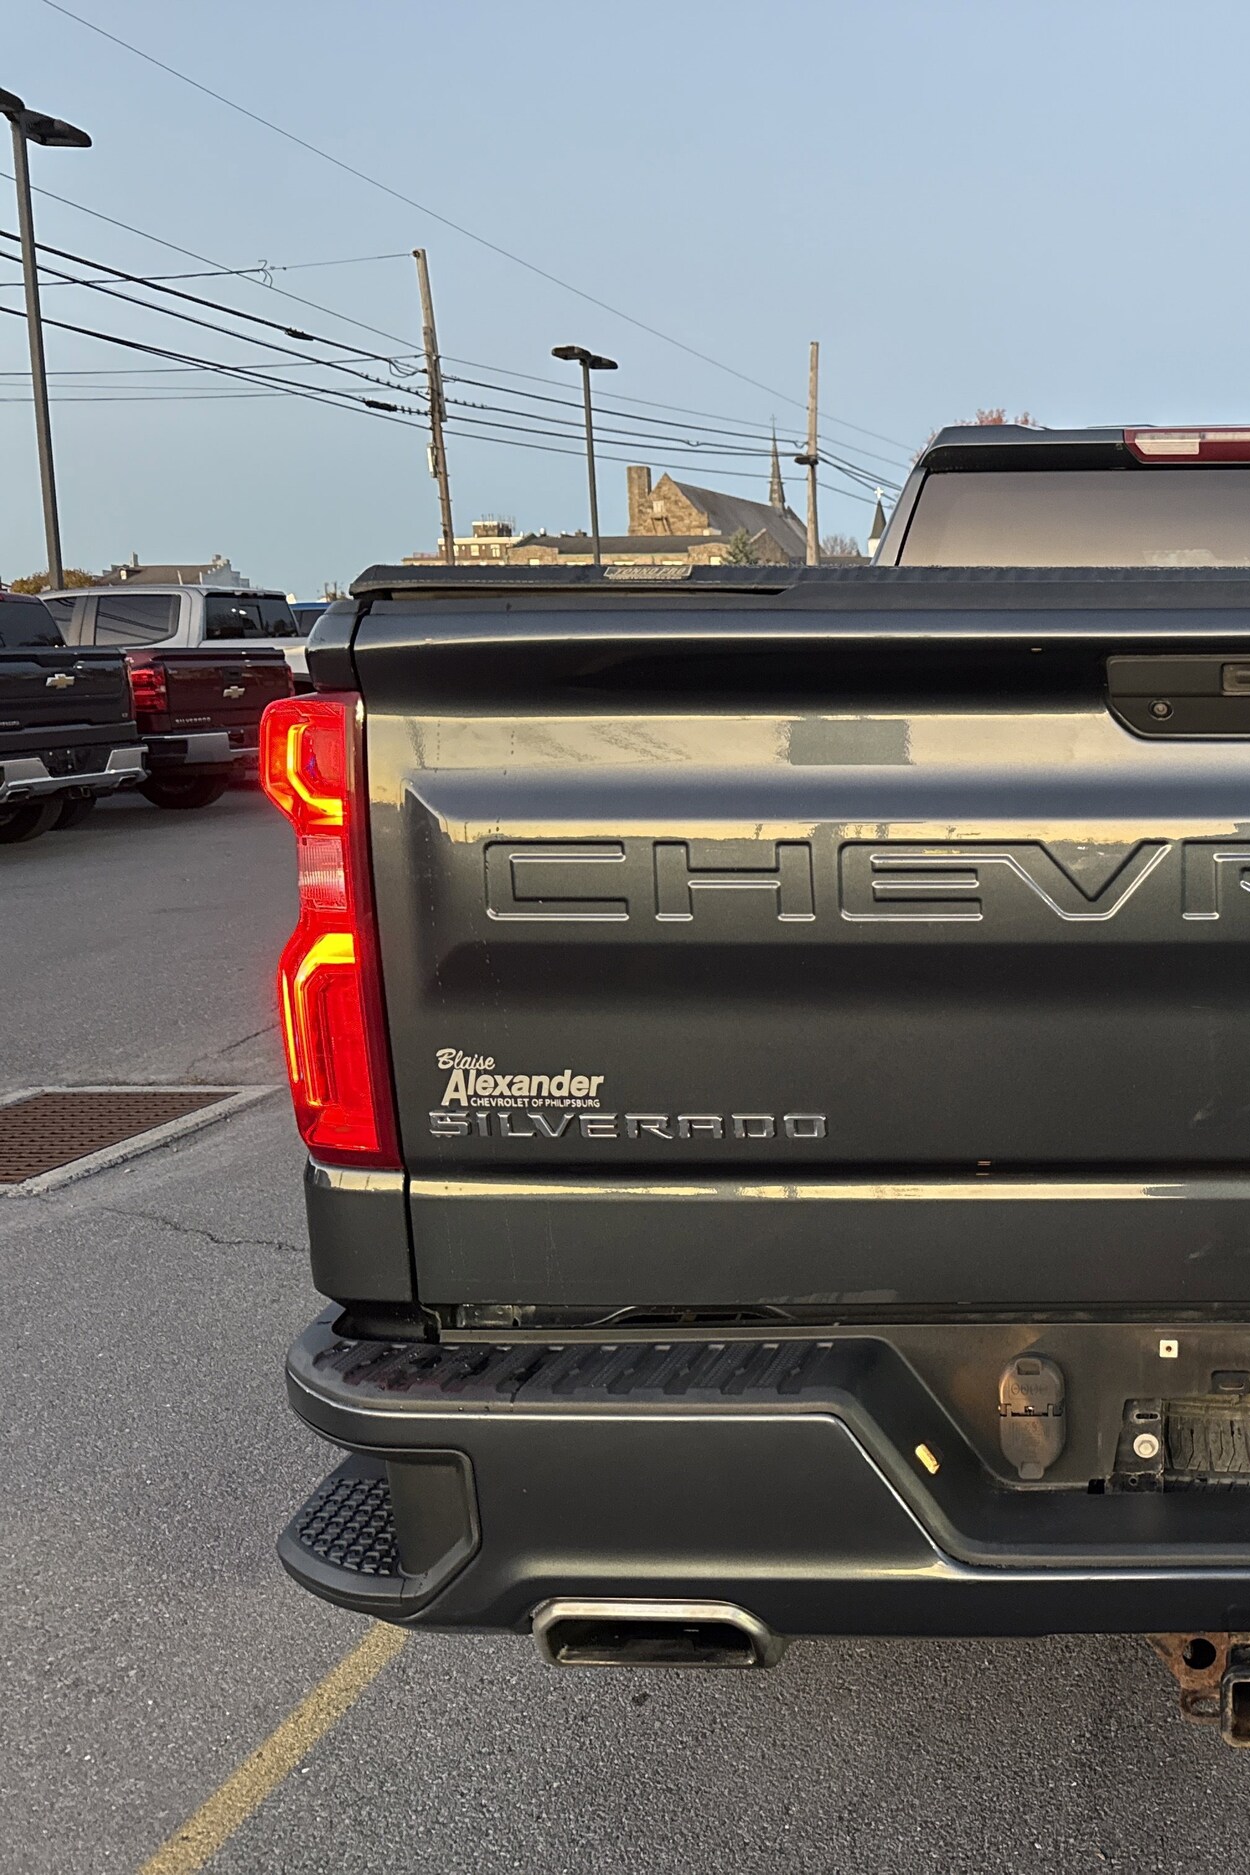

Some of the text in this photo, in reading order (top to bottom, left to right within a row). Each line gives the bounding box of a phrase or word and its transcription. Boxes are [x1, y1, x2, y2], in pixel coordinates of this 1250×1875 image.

[436, 1047, 496, 1070] Blaise
[441, 1068, 605, 1107] Alexander
[470, 1097, 601, 1108] CHEVROLET OF PHILIPSBURG
[428, 1110, 828, 1140] SILVERADO
